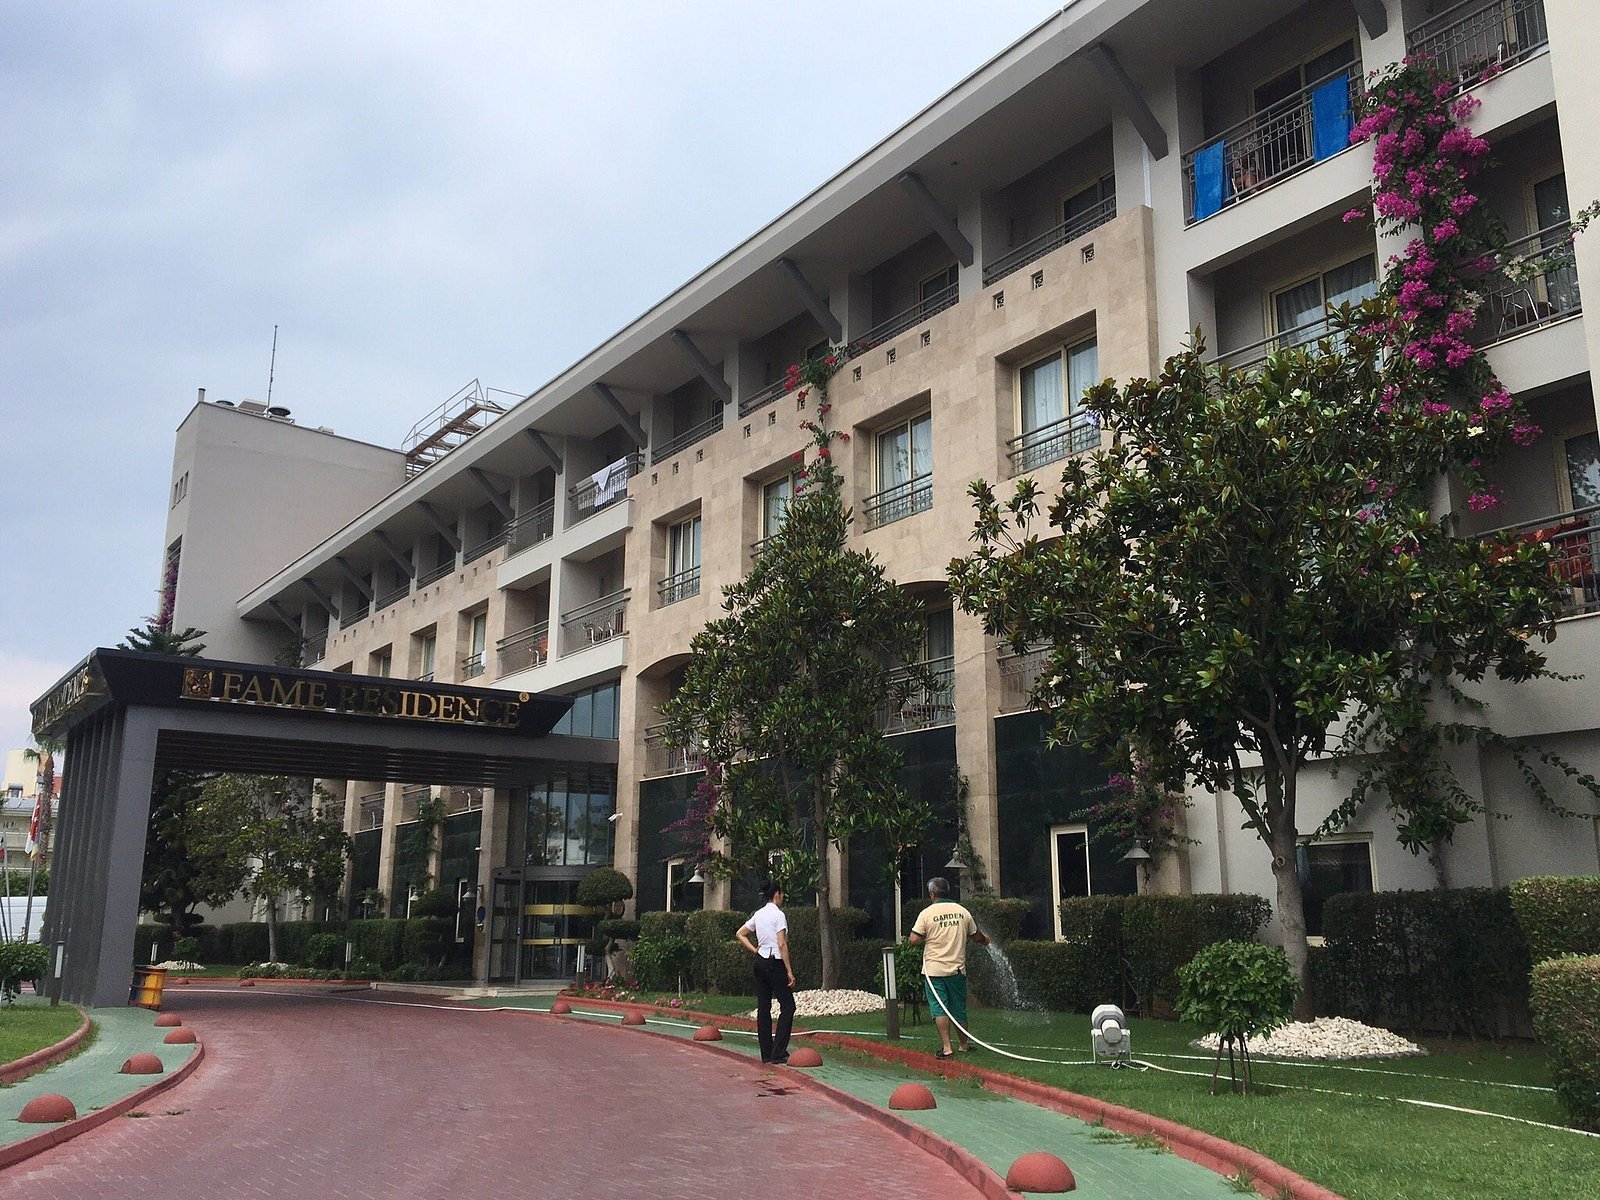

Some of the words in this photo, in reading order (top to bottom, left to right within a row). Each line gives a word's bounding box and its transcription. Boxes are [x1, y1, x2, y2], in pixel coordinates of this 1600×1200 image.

[220, 672, 328, 709] FAME
[932, 912, 964, 922] GARDEN
[939, 920, 960, 928] TEAM
